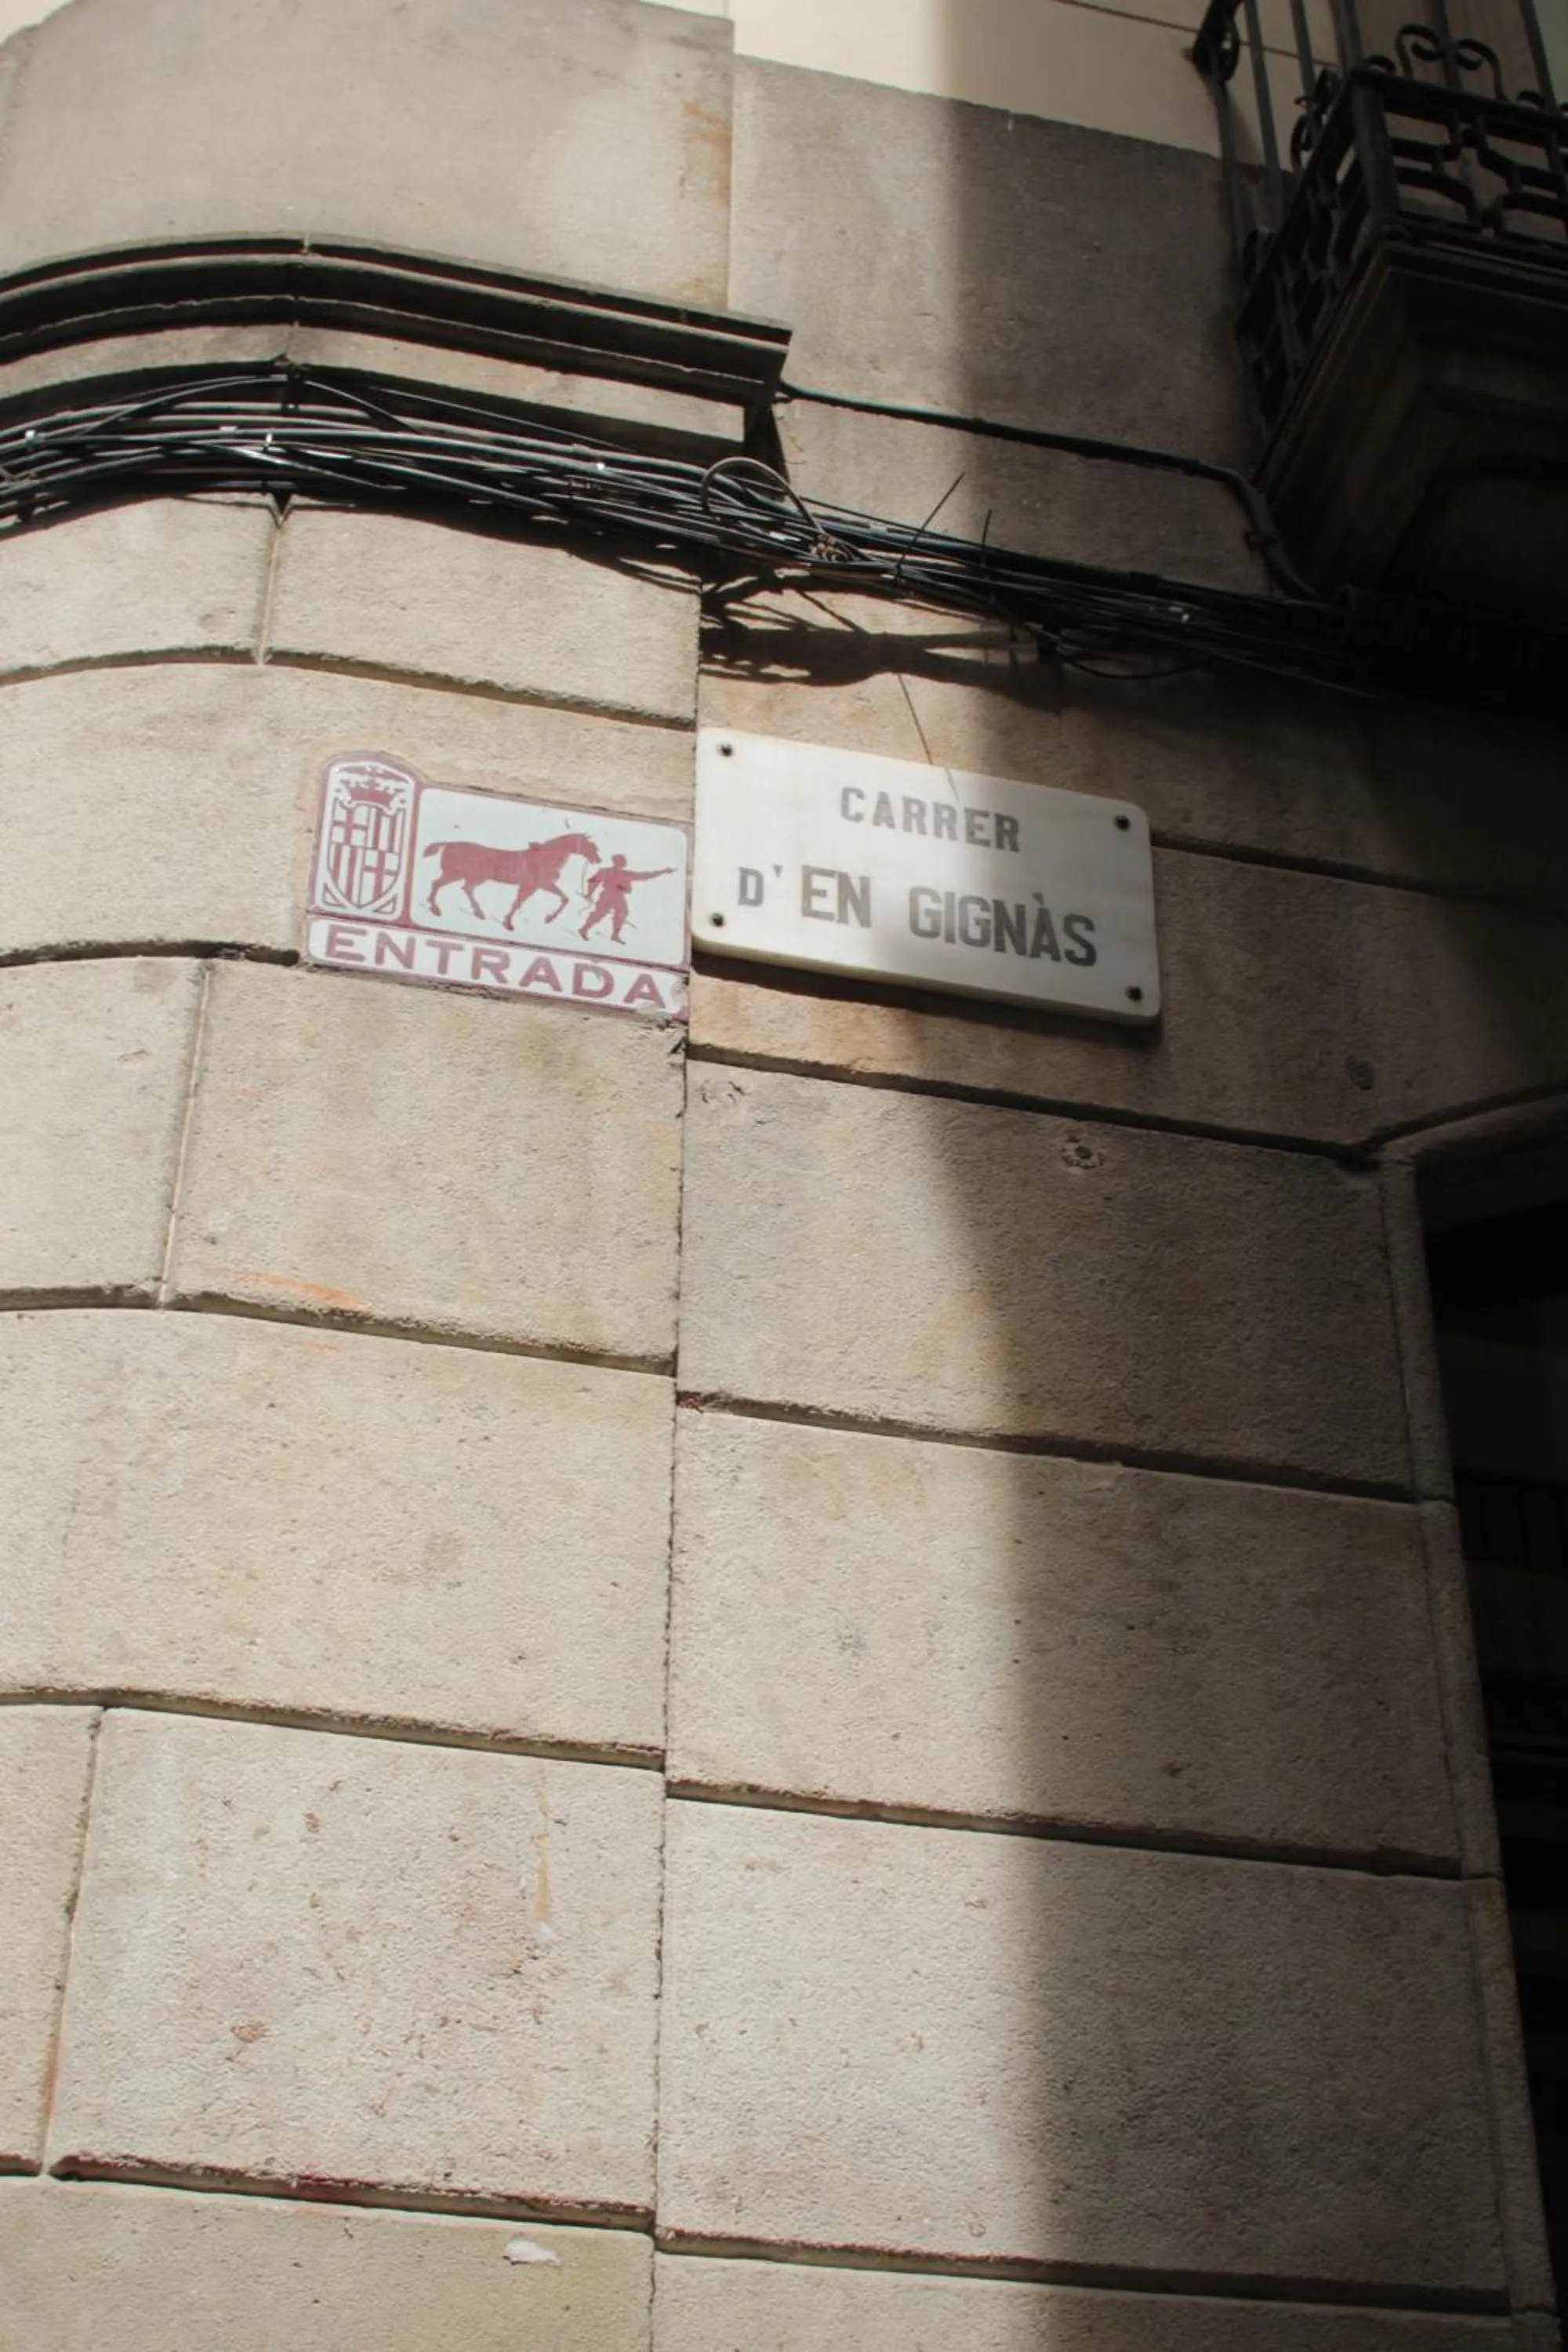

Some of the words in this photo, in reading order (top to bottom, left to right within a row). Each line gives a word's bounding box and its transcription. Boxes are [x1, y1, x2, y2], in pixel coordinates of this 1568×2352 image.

[840, 786, 1020, 853] CARRER
[325, 925, 666, 1008] ENTRADA
[909, 891, 1097, 967] GIGNÀS
